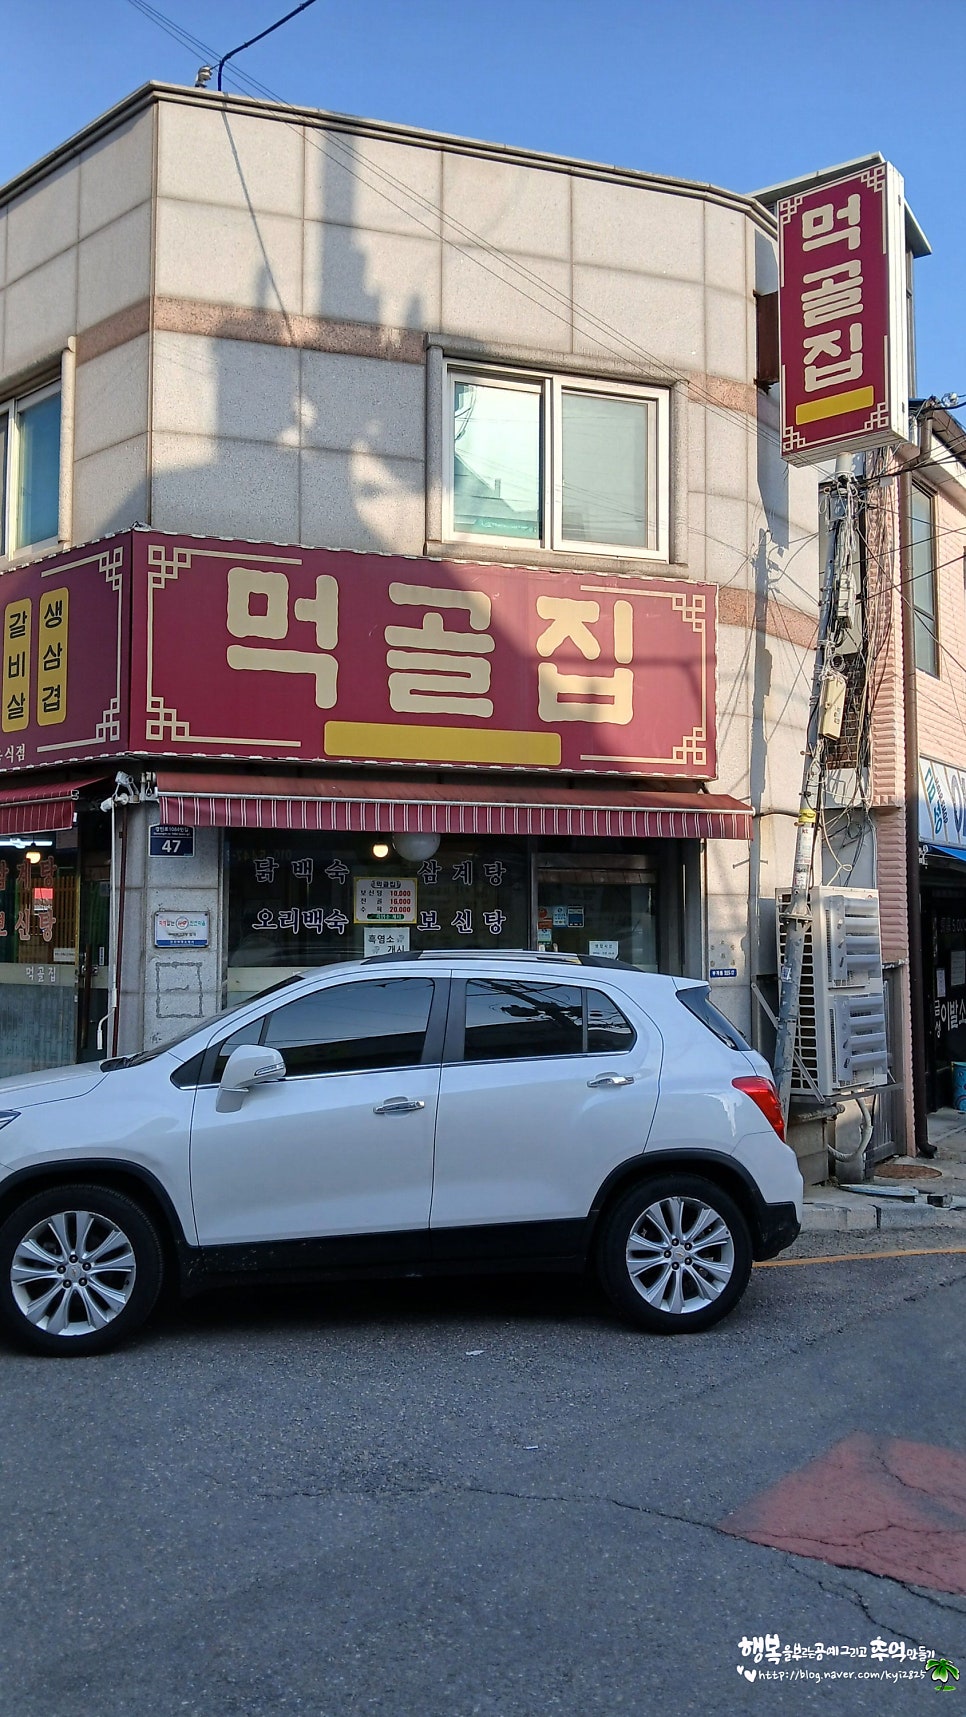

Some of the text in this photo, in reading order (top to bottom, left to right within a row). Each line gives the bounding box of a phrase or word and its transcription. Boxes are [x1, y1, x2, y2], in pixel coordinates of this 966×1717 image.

[801, 193, 864, 393] 먹골집
[6, 610, 28, 720] 갈비살
[42, 598, 63, 714] 생삼겹
[227, 567, 635, 726] 먹골집
[161, 839, 181, 853] 47
[252, 908, 350, 935] 오리백숙
[368, 934, 395, 944] 흑염소
